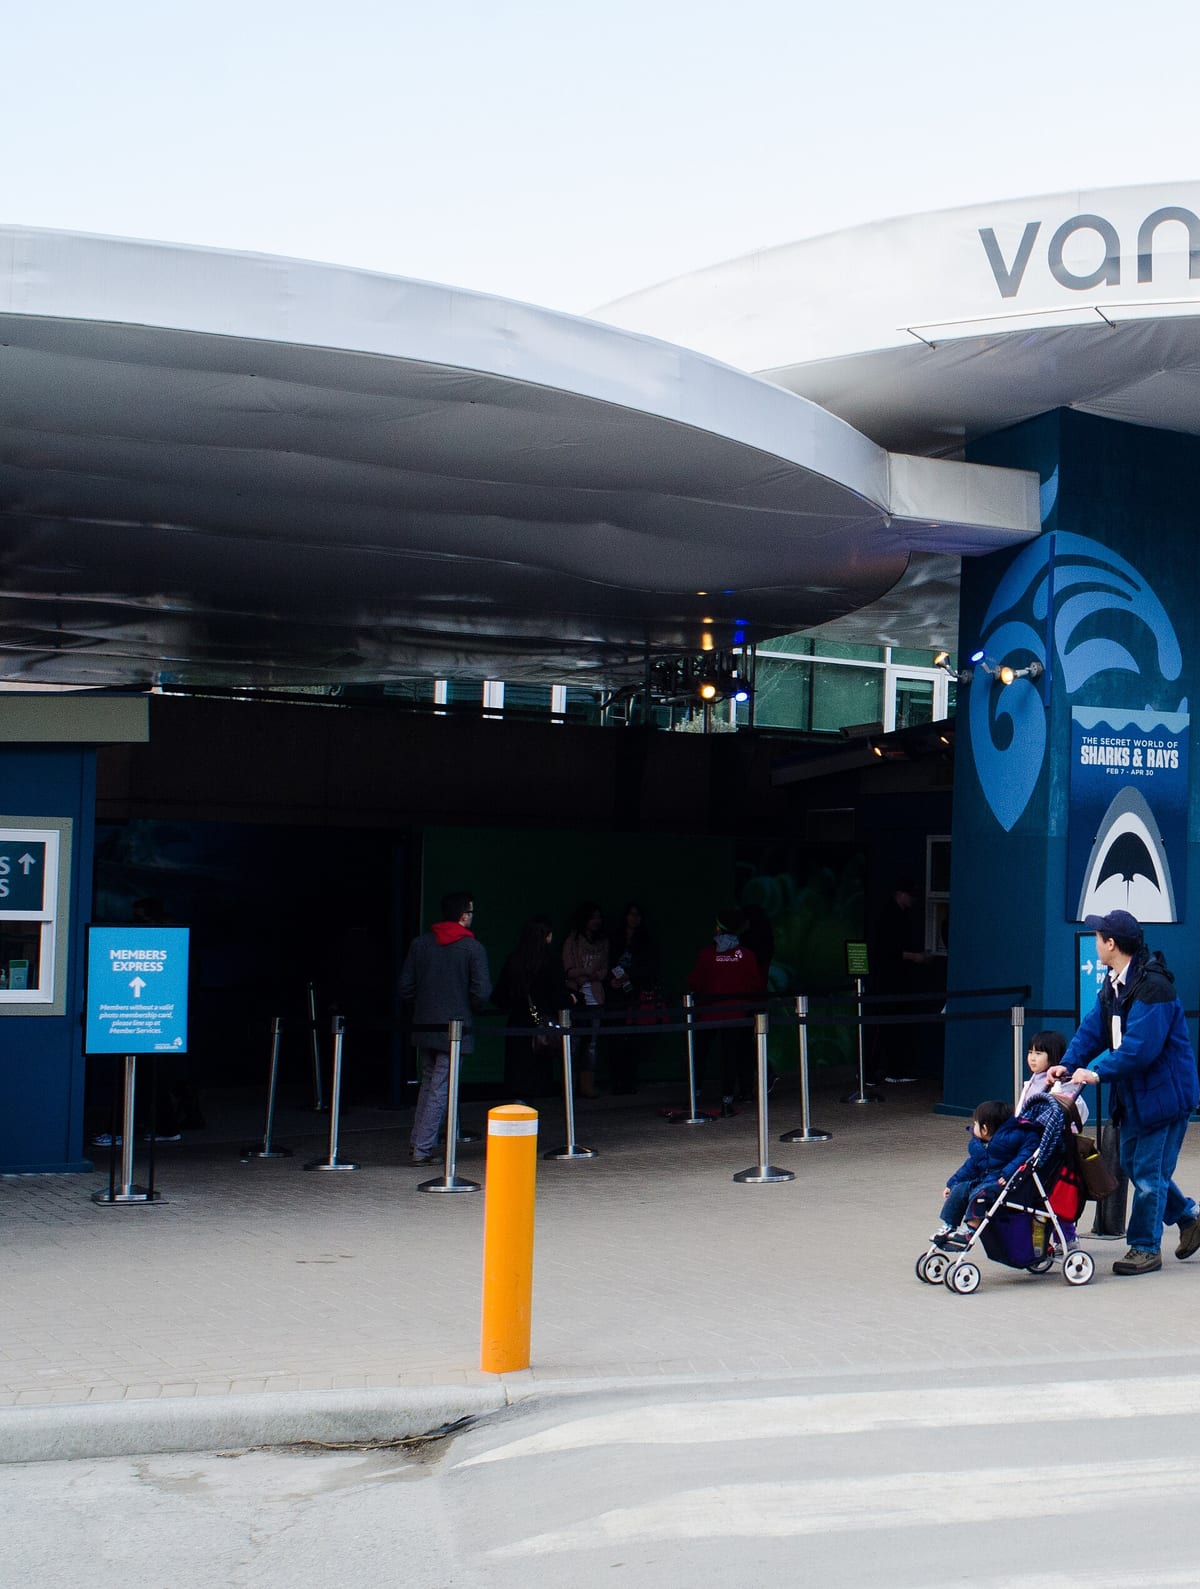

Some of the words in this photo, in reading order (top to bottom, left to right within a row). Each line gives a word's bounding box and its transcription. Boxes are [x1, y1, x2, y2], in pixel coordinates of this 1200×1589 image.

[1082, 736, 1098, 745] THE
[1100, 737, 1131, 747] SECRET
[1133, 739, 1164, 748] WORLD
[1167, 741, 1179, 749] OF
[1080, 745, 1130, 767] SHARKS
[1132, 748, 1143, 767] &
[1146, 748, 1179, 769] RAYS
[109, 949, 167, 960] MEMBERS
[112, 961, 164, 972] EXPRESS
